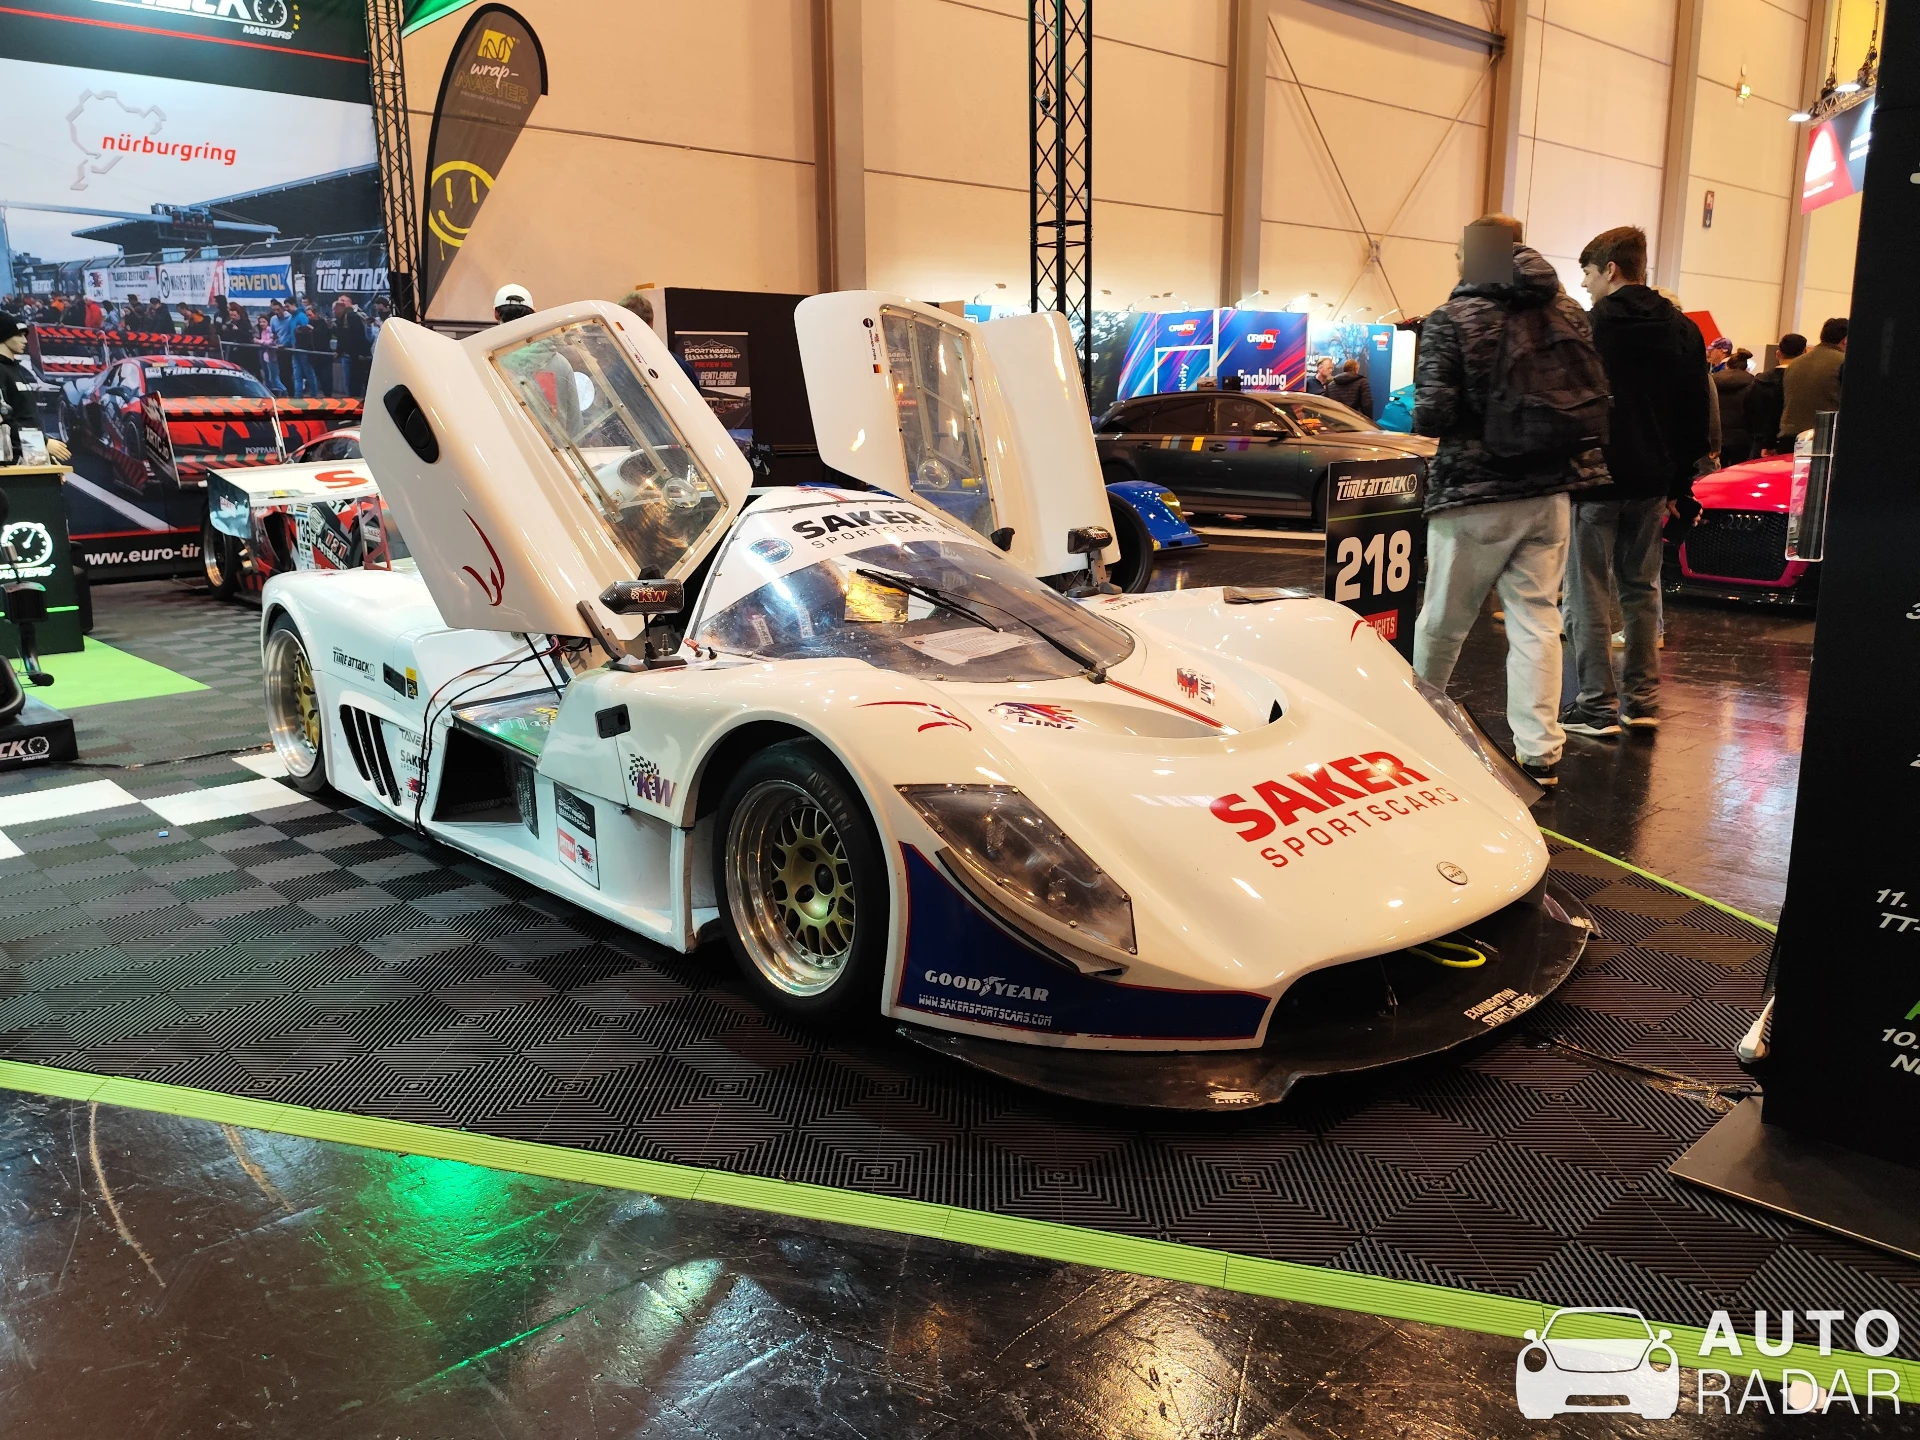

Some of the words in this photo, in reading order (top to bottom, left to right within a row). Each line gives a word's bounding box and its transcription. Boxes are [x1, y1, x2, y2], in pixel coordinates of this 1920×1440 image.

[242, 25, 292, 40] MASTERS
[455, 70, 529, 105] MASTER
[102, 133, 236, 166] nürburgring
[229, 274, 286, 291] RAVENOL
[1246, 333, 1277, 344] ORAFOL
[700, 371, 738, 380] GENTLEMEN
[1238, 368, 1287, 390] Enabling
[792, 510, 931, 540] SAKER
[1335, 530, 1411, 603] 218
[638, 590, 668, 602] KW
[637, 770, 677, 807] KW
[1209, 751, 1430, 842] SAKER
[1260, 787, 1459, 868] SPORTSCARS
[1875, 889, 1908, 908] 11.
[918, 994, 1053, 1027] WWW.SAKERSPORTSCARS.COM
[1881, 1028, 1920, 1050] 10.
